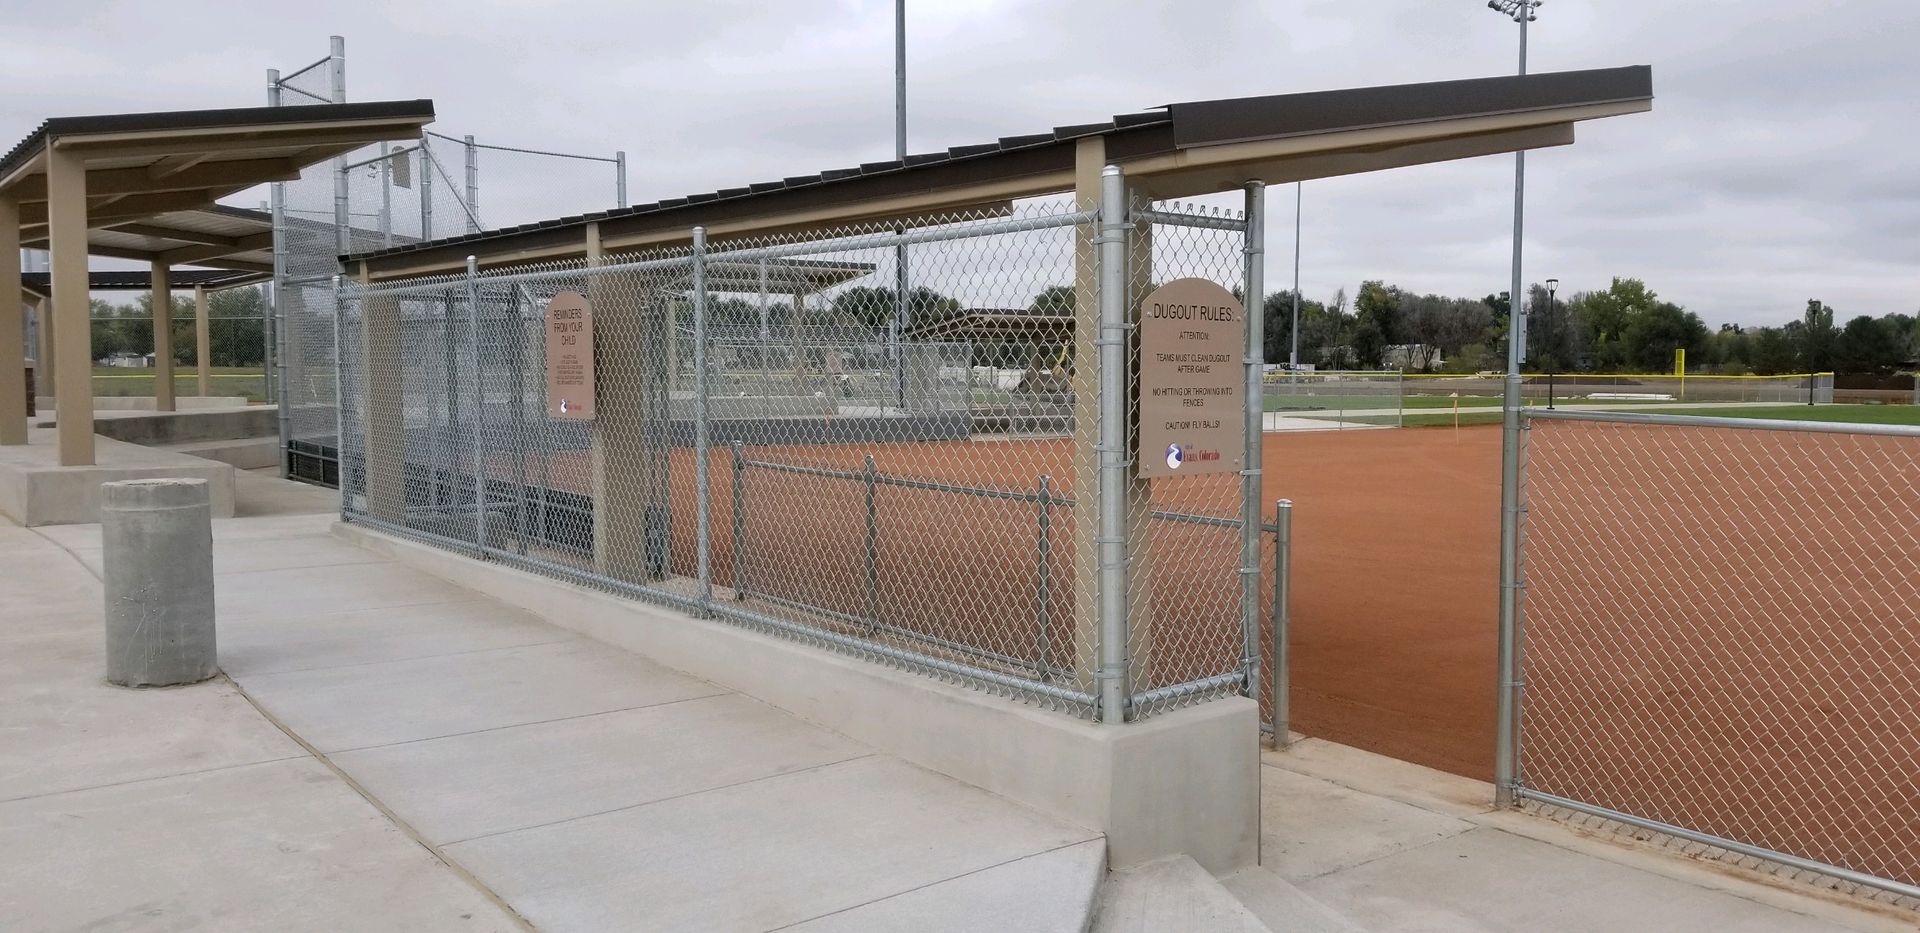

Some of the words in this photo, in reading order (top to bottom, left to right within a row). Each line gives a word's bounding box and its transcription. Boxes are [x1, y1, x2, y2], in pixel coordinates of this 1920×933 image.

[1153, 303, 1198, 320] DUGOUT
[1200, 305, 1235, 322] RULES:
[561, 335, 576, 345] CHILD
[1156, 353, 1174, 362] TEAMS
[1175, 353, 1190, 362] MUST
[1191, 354, 1208, 363] CLEAN
[1209, 354, 1231, 363] DUGOUT
[1177, 365, 1195, 374] AFTER
[1195, 365, 1211, 374] GAME
[1152, 387, 1161, 396] NO
[1161, 387, 1183, 396] HITTING
[1183, 387, 1192, 396] OR
[1192, 387, 1220, 396] THROWING
[1220, 387, 1233, 396] INTO
[1182, 398, 1204, 408] FENCES
[1192, 420, 1202, 429] FLY
